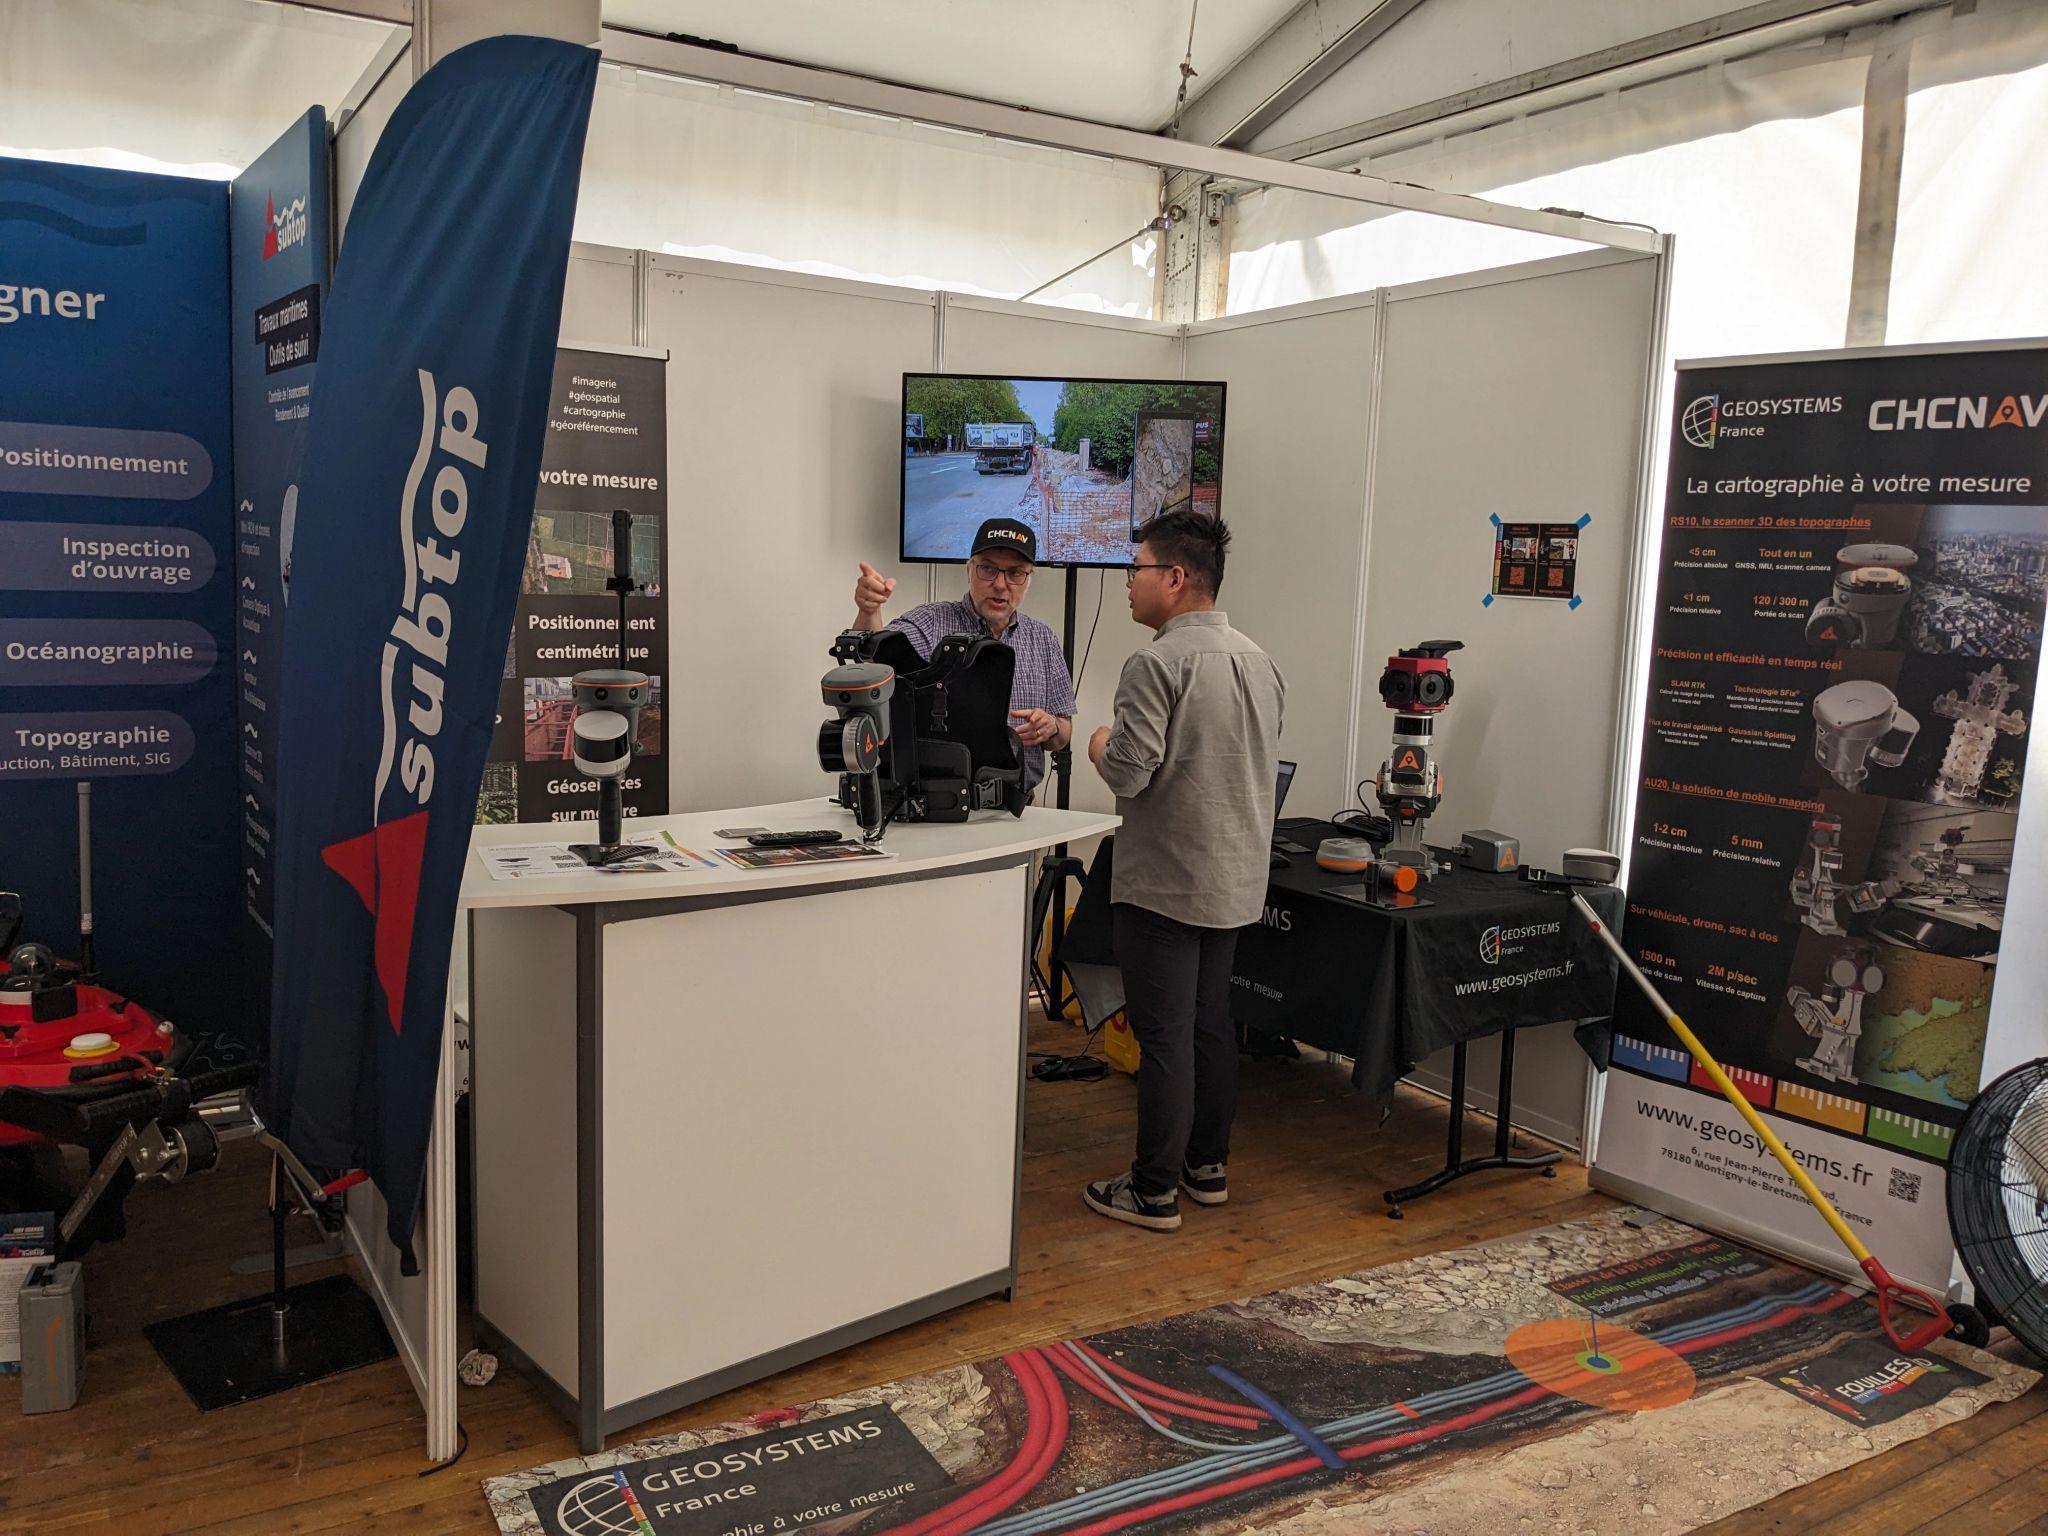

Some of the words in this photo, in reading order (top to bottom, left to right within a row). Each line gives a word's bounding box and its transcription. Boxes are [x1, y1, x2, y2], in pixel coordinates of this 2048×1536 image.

[278, 214, 306, 252] subtop
[259, 312, 279, 335] Travaux
[280, 299, 309, 327] maritimes
[269, 342, 285, 366] Outils
[286, 339, 294, 361] de
[295, 333, 309, 359] suivi
[572, 375, 617, 389] #imagerie
[569, 391, 620, 403] #géospatial
[563, 405, 626, 419] #cartographie
[1722, 397, 1843, 417] GEOSYSTEMS
[1868, 395, 2048, 431] CHCNAV
[550, 419, 639, 435] #géoréférencement
[1719, 426, 1765, 437] France
[0, 448, 188, 475] ositionnement
[539, 469, 588, 486] votre
[592, 474, 658, 490] mesure
[1687, 477, 1708, 494] La
[1715, 474, 1844, 497] cartographie
[1851, 473, 1864, 492] à
[1872, 474, 1931, 493] votre
[1939, 477, 2031, 493] mesure
[1670, 516, 1699, 527] RS10,
[1702, 516, 1712, 526] le
[1713, 517, 1754, 526] scanner
[1758, 517, 1773, 526] 3D
[1776, 517, 1796, 526] des
[1799, 517, 1872, 528] topographes
[987, 529, 1028, 544] CHCNAV
[63, 537, 190, 561] Inspection
[1689, 548, 1700, 557] <5
[1701, 549, 1716, 557] cm
[1759, 549, 1783, 558] Tout
[71, 560, 192, 585] d'ouvrage
[1735, 562, 1757, 570] GNSS,
[1775, 564, 1805, 572] scanner,
[391, 386, 488, 805] subtop
[1696, 594, 1710, 602] cm
[1753, 595, 1770, 605] 120
[1779, 596, 1797, 606] 300
[1799, 598, 1809, 606] m
[1669, 606, 1698, 614] Précision
[1699, 607, 1722, 615] relative
[1754, 609, 1777, 618] Portée
[6, 641, 193, 665] Océanographie
[1657, 648, 1702, 660] Précision
[1703, 652, 1713, 661] et
[1715, 652, 1765, 665] efficacité
[1768, 658, 1781, 666] en
[1784, 658, 1817, 670] temps
[1820, 659, 1842, 670] réel
[1670, 680, 1690, 688] SLAM
[1691, 681, 1706, 689] RTK
[1734, 684, 1779, 696] Technologie
[1671, 721, 1692, 729] travail
[1692, 723, 1723, 733] optimisé
[1728, 726, 1762, 736] Gaussian
[1763, 730, 1797, 741] Splatting
[15, 726, 170, 750] Topographie
[60, 754, 141, 768] Bâtiment,
[145, 752, 171, 765] SIG
[547, 778, 642, 794] Géoseces
[1644, 778, 1670, 790] AU20,
[1672, 781, 1681, 791] la
[1682, 782, 1724, 797] solution
[1726, 788, 1739, 799] de
[1741, 790, 1777, 804] mobile
[1778, 797, 1825, 812] mapping
[551, 810, 577, 822] sur
[1653, 822, 1668, 834] 1-2
[1670, 827, 1687, 838] cm
[1639, 836, 1671, 849] Précision
[1672, 843, 1703, 855] absolue
[1730, 834, 1739, 845] 5
[1741, 838, 1763, 850] mm
[1712, 849, 1751, 862] Précision
[1751, 856, 1781, 868] relative
[1258, 905, 1292, 931] MS
[1630, 903, 1646, 916] Sur
[1647, 908, 1691, 926] véhicule,
[1693, 917, 1727, 933] drone,
[1729, 925, 1747, 937] sac
[1749, 928, 1756, 939] à
[1759, 930, 1779, 943] dos
[1501, 922, 1560, 941] GEOSYSTEMS
[1501, 945, 1524, 956] France
[1639, 949, 1663, 964] 1500
[1665, 958, 1676, 967] m
[1455, 960, 1575, 996] www.geosystems.fr
[1653, 970, 1663, 978] de
[1664, 973, 1683, 983] scan
[1707, 964, 1725, 978] 2M
[1727, 970, 1758, 985] p/sec
[1253, 982, 1283, 1001] mesure
[1695, 978, 1724, 992] Vitesse
[1725, 985, 1735, 994] de
[1736, 989, 1767, 1002] capture
[1660, 1147, 1692, 1165] 78180
[1690, 1146, 1701, 1157] 6,
[1704, 1152, 1722, 1163] rue
[1724, 1157, 1785, 1184] Jean-Pierre
[642, 1420, 882, 1492] GEOSYSTEMS
[655, 1484, 757, 1518] France
[773, 1516, 786, 1529] à
[793, 1502, 842, 1522] votre
[850, 1482, 916, 1509] mesure
